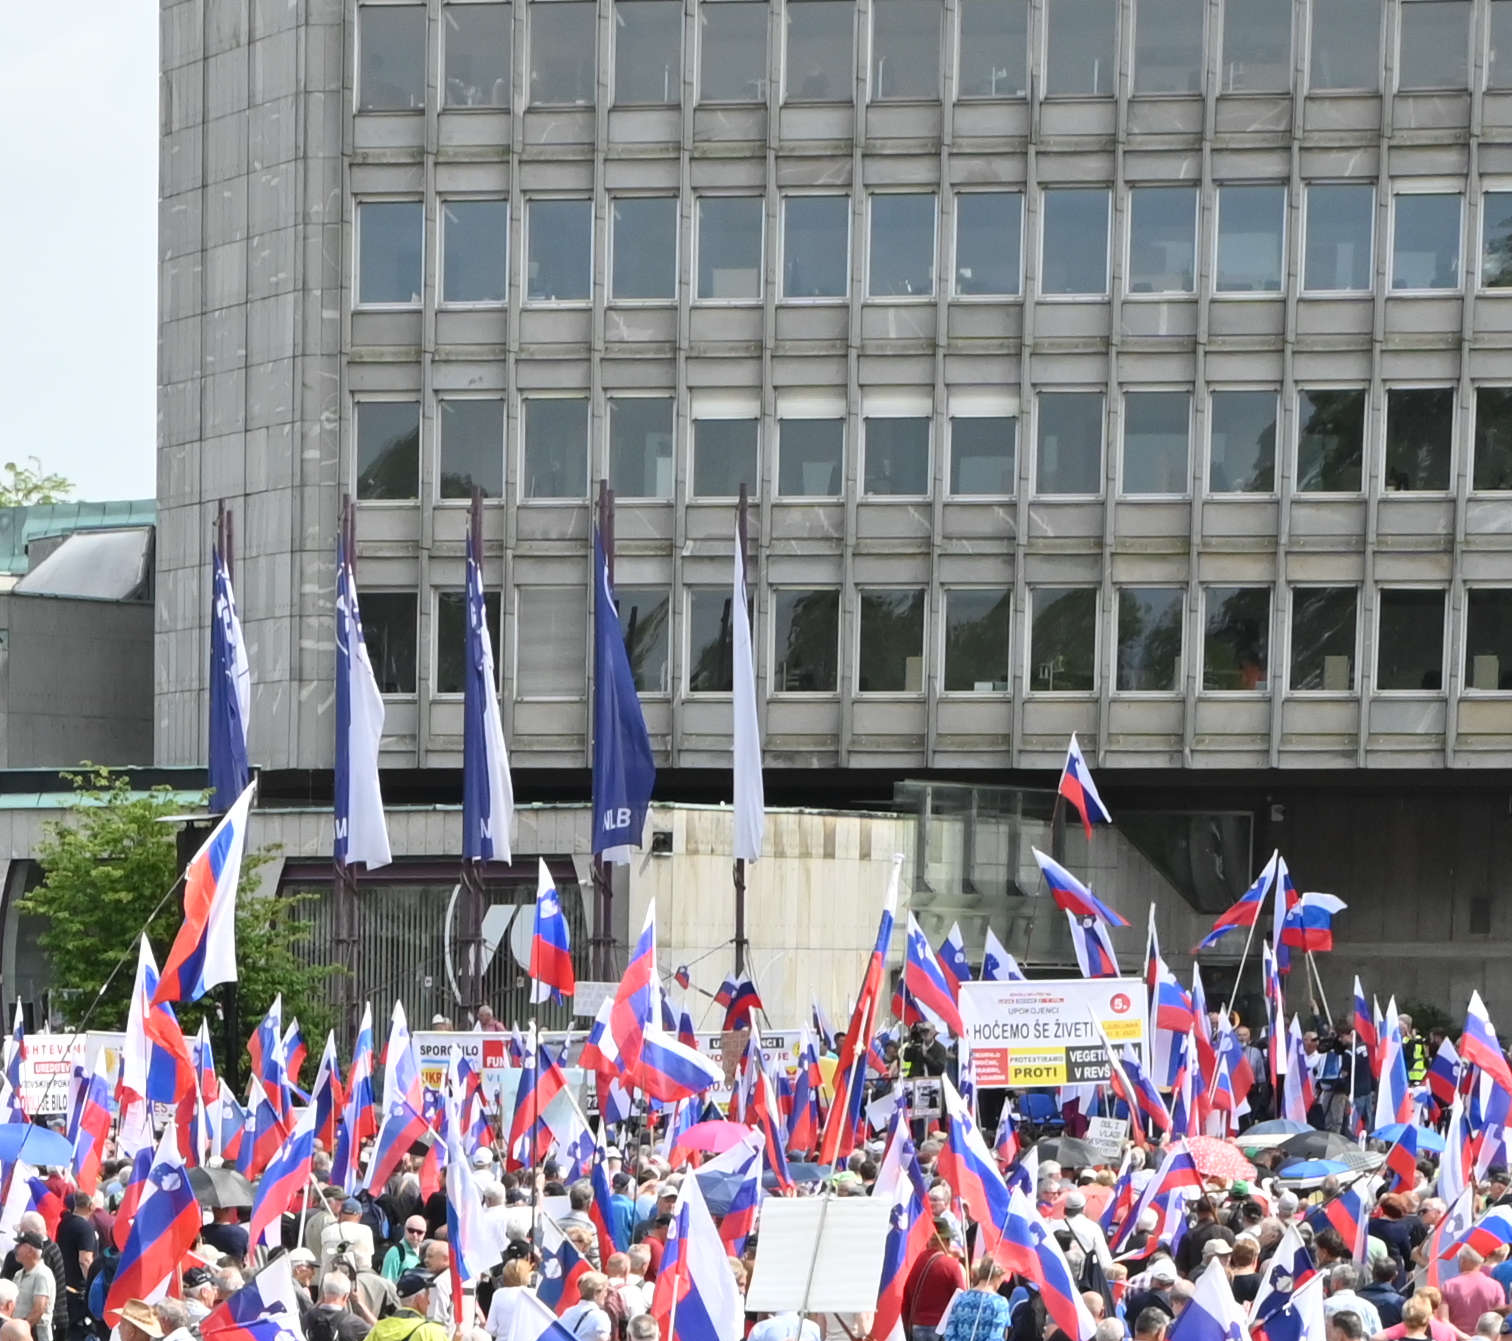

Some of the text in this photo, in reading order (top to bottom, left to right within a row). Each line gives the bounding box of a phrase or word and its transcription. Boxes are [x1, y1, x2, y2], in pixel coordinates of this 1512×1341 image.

[602, 808, 631, 831] NLB
[974, 1020, 1029, 1040] HOČEMO
[1034, 1019, 1050, 1038] ŠE
[1054, 1018, 1093, 1038] ŽIVETI
[420, 1043, 478, 1056] SPOROILO
[1014, 1067, 1057, 1078] PROTI
[1075, 1068, 1081, 1079] V
[52, 1095, 67, 1111] BILO
